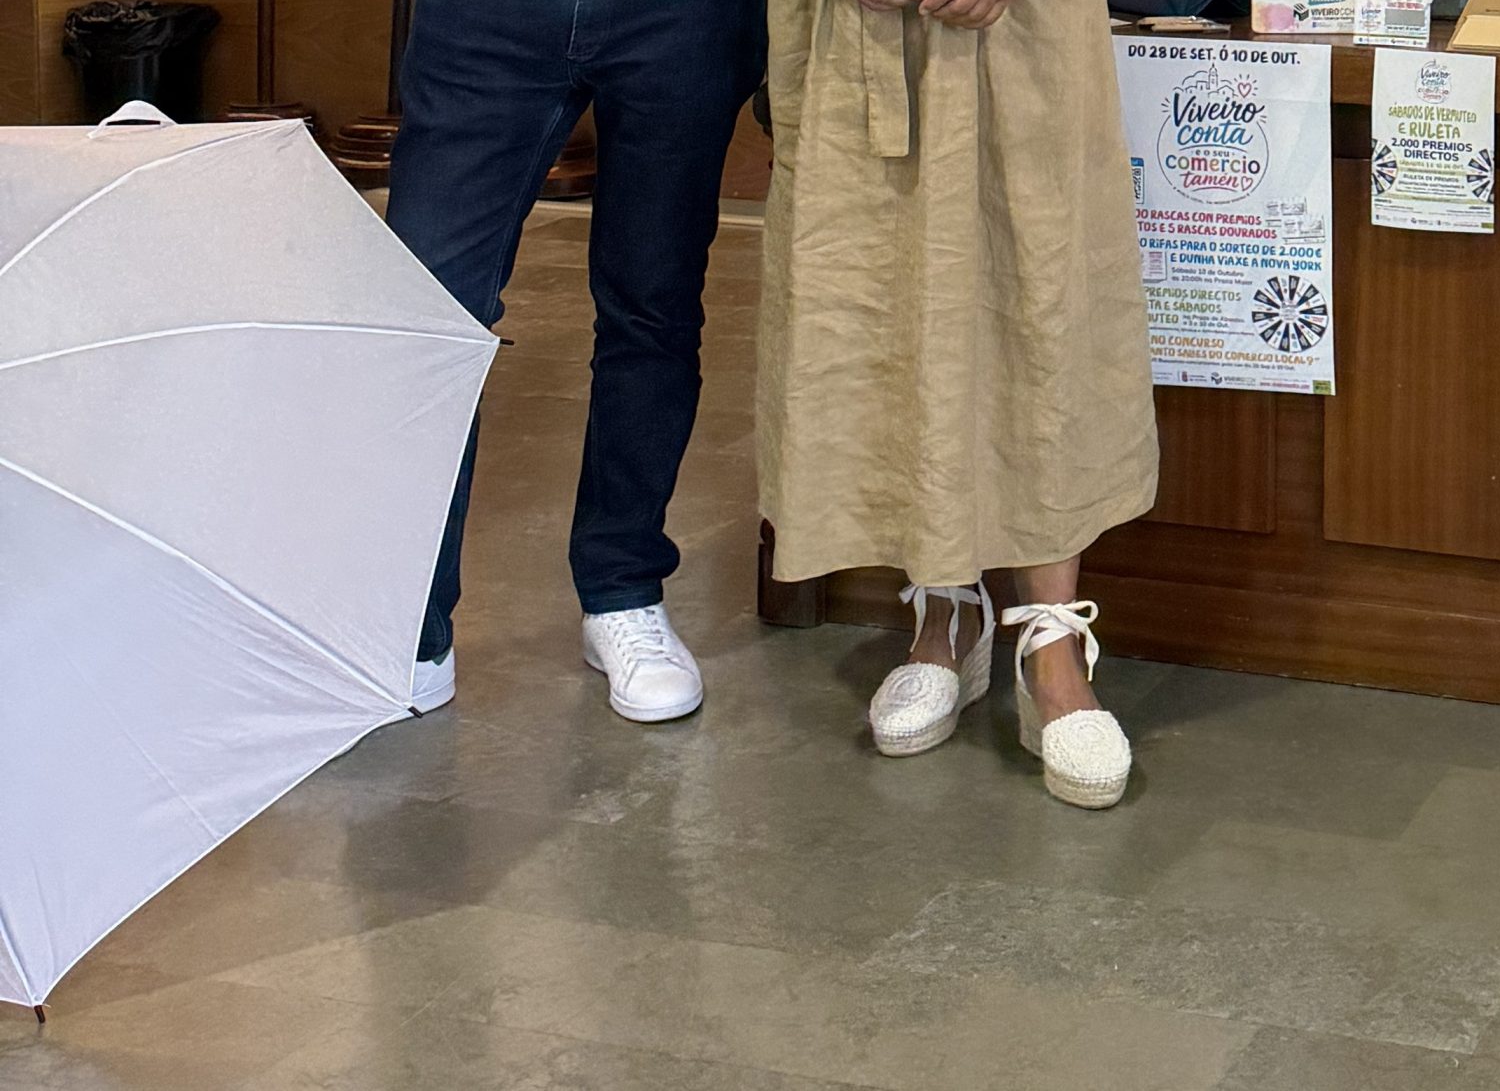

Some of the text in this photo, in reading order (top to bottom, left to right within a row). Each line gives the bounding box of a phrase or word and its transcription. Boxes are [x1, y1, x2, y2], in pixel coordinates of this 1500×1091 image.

[1128, 44, 1301, 65] DO 28 DE SET. Ó 10 DE OUT.
[1174, 93, 1265, 127] Viveiro
[1425, 106, 1435, 121] DE
[1178, 120, 1253, 146] conta
[1398, 121, 1461, 139] E RULETA
[1391, 138, 1474, 153] 2.000 PREMIOS
[1404, 149, 1460, 162] DIRECTOS
[1166, 155, 1260, 174] comercio
[1180, 171, 1239, 188] tamén
[1151, 210, 1190, 222] RASCAS
[1192, 212, 1214, 223] CON
[1160, 223, 1167, 233] E
[1177, 224, 1218, 236] RASCAS
[1219, 226, 1278, 239] DOURADOS
[1180, 240, 1208, 252] PARA
[1210, 241, 1218, 252] O
[1219, 243, 1260, 255] SORTEO
[1262, 245, 1277, 256] DE
[1171, 253, 1178, 263] E
[1179, 253, 1216, 265] DUNHA
[1251, 258, 1260, 269] A
[1261, 258, 1291, 270] NOVA
[1292, 260, 1323, 272] YORK
[1172, 299, 1223, 314] SÁBADOS
[1168, 335, 1225, 349] CONCURSO
[1224, 351, 1274, 363] COMERCIO
